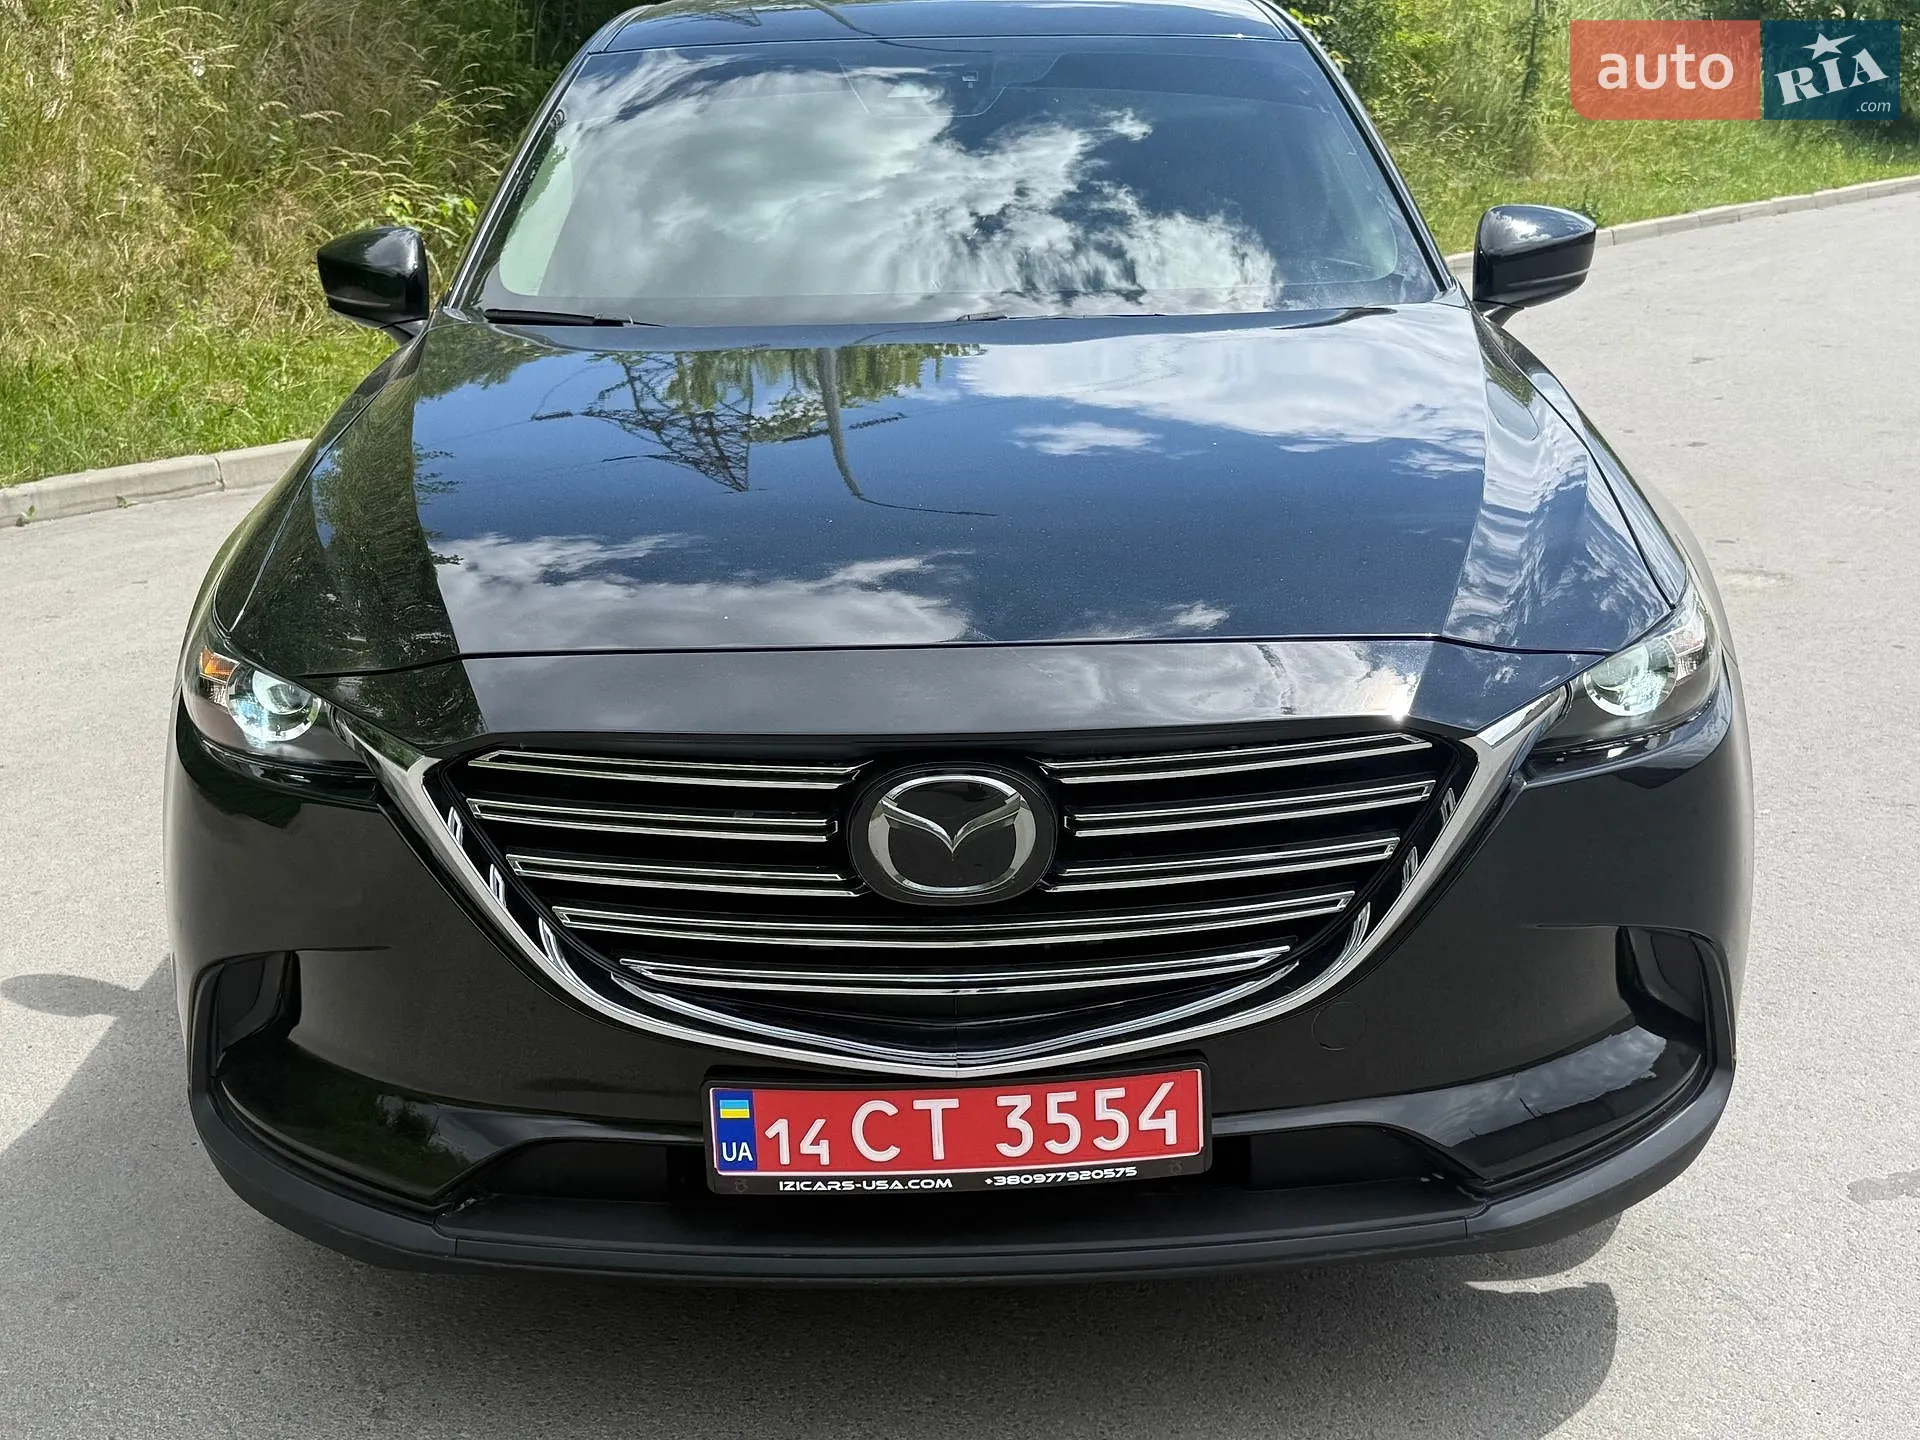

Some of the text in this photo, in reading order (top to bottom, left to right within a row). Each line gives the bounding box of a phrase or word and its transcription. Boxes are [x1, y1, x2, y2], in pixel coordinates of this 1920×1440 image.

[764, 1081, 1178, 1165] 14 CT 3554
[722, 1141, 753, 1162] UA
[779, 1177, 953, 1191] IZICARS-USA.COM
[985, 1166, 1138, 1187] +380977920575
